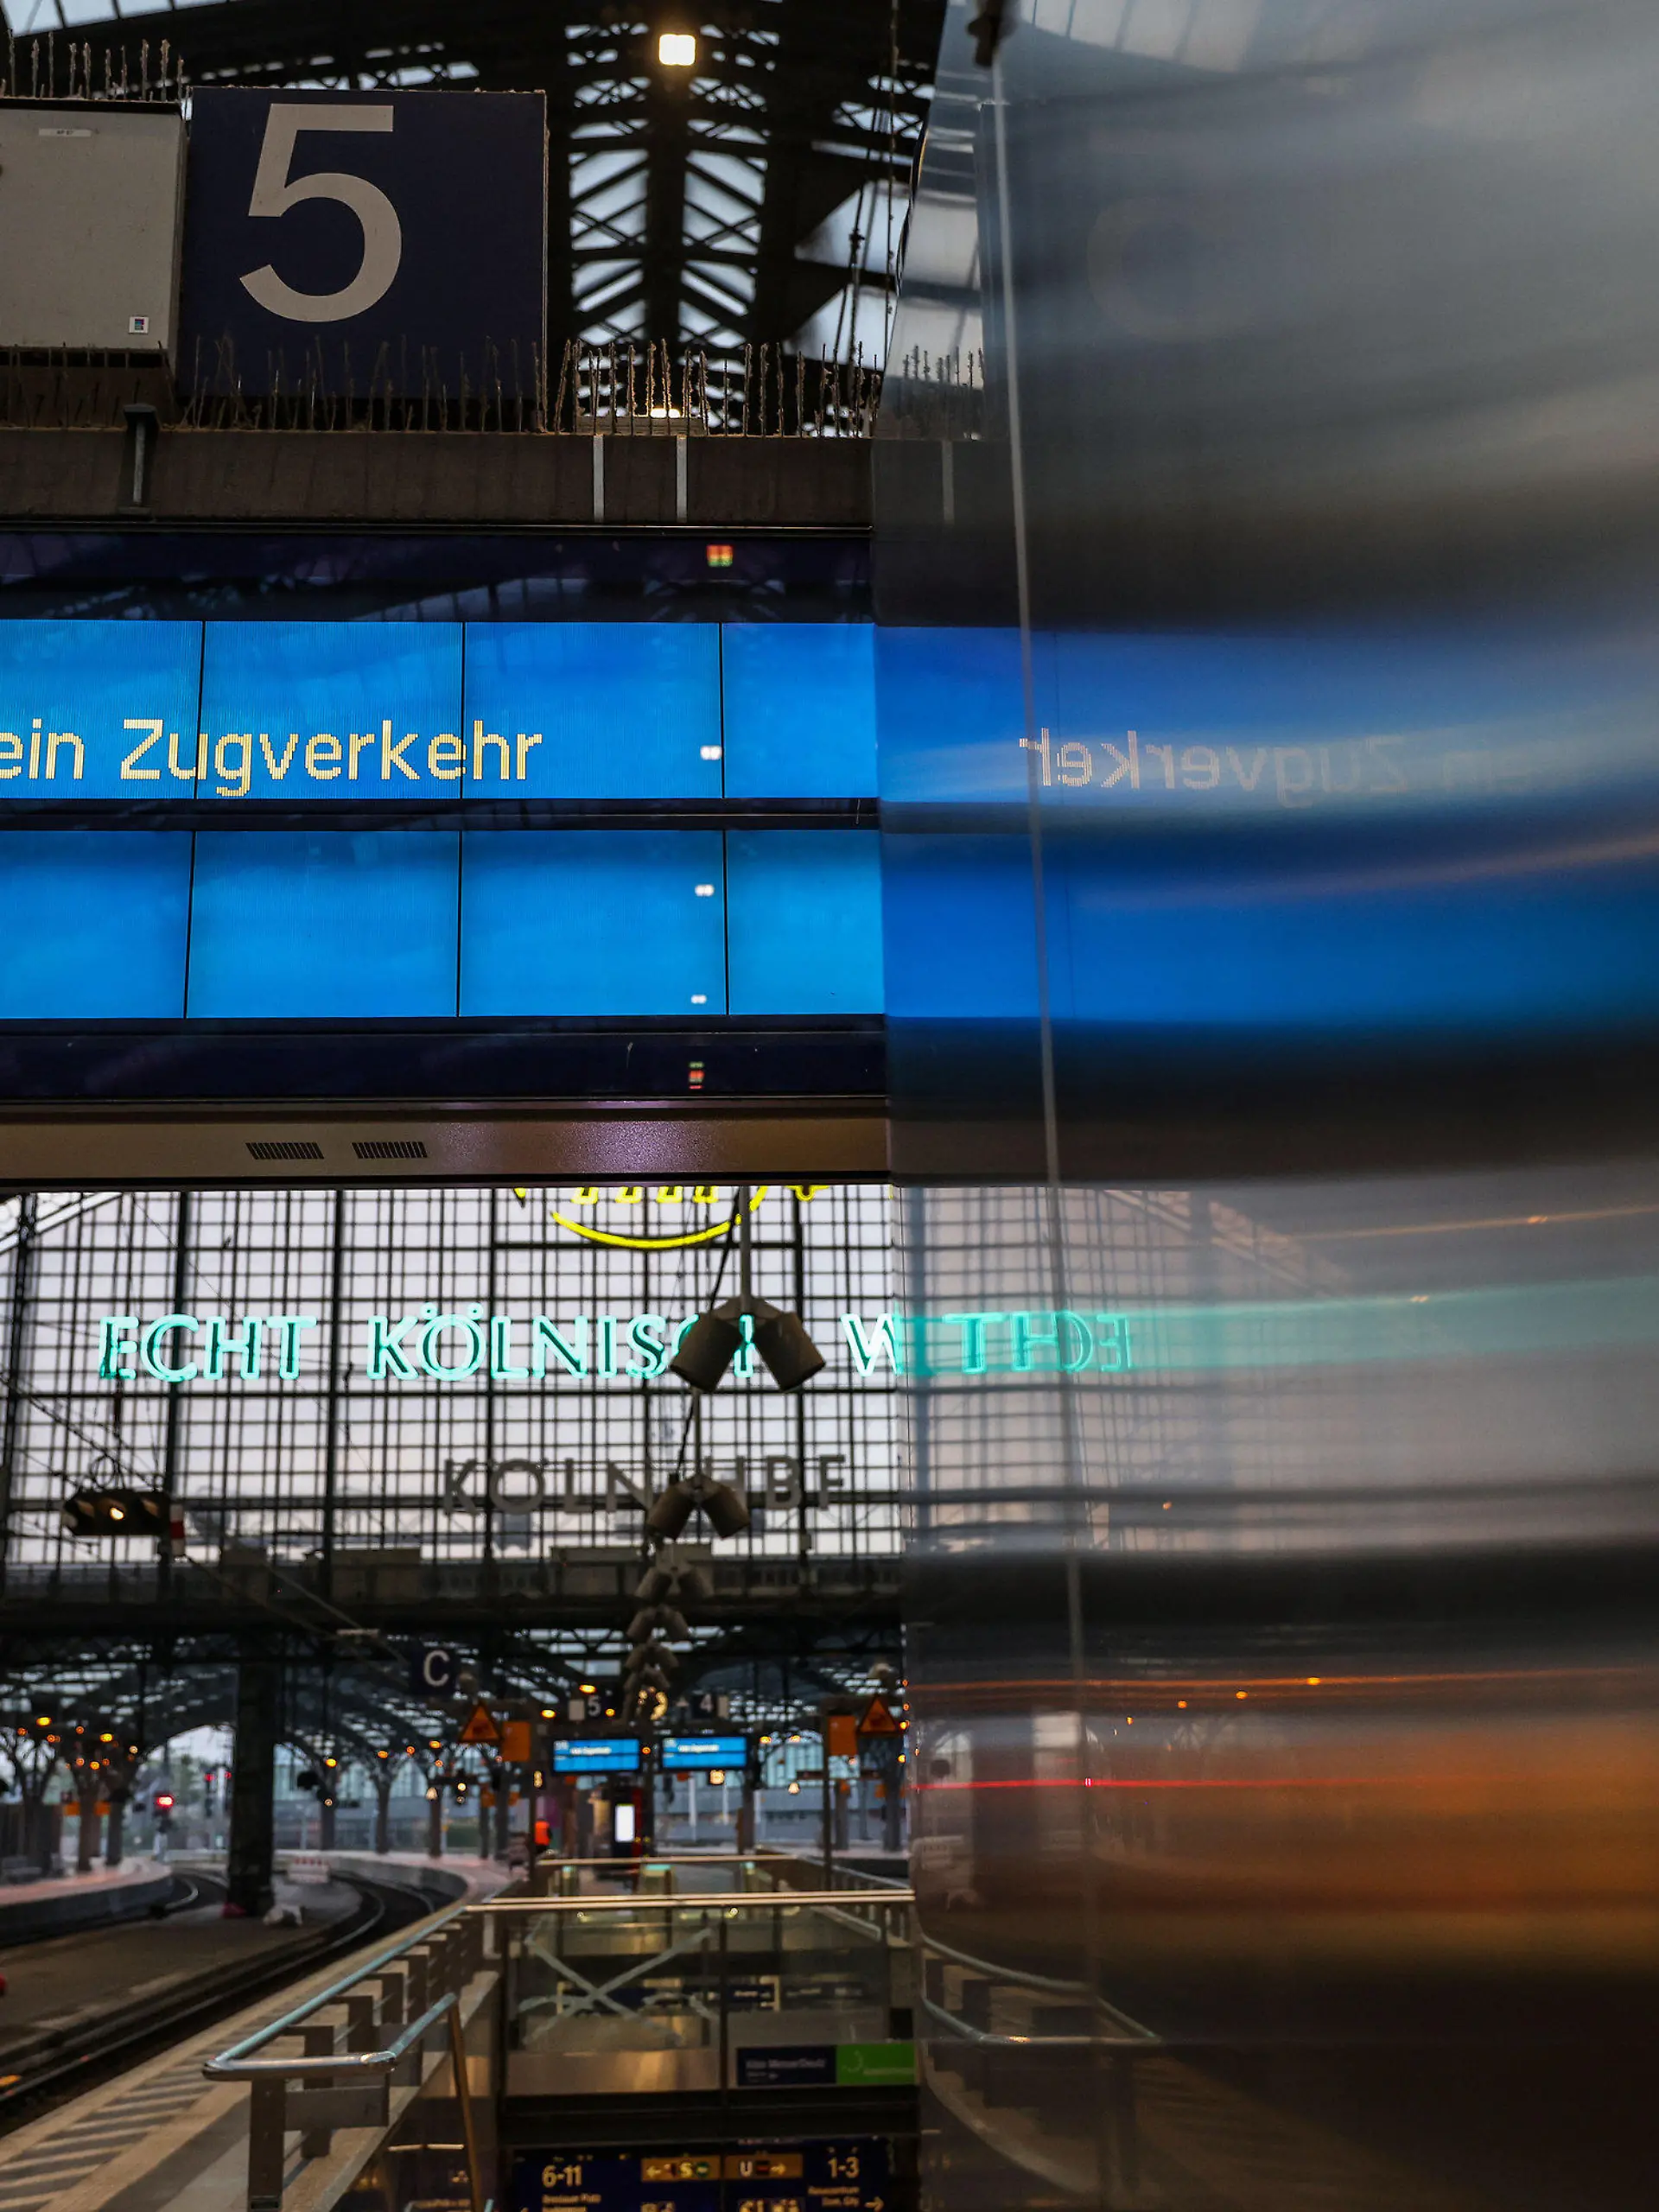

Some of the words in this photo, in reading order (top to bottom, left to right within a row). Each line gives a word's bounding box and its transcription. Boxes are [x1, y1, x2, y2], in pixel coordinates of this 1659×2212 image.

[240, 103, 403, 323] 5
[120, 719, 543, 798] Zugverkehr
[99, 1313, 317, 1382] ECHT
[423, 1649, 450, 1688] C
[588, 1695, 601, 1717] 5
[699, 1693, 713, 1713] 4
[541, 2164, 582, 2188] 6-11
[828, 2156, 860, 2178] 1-3
